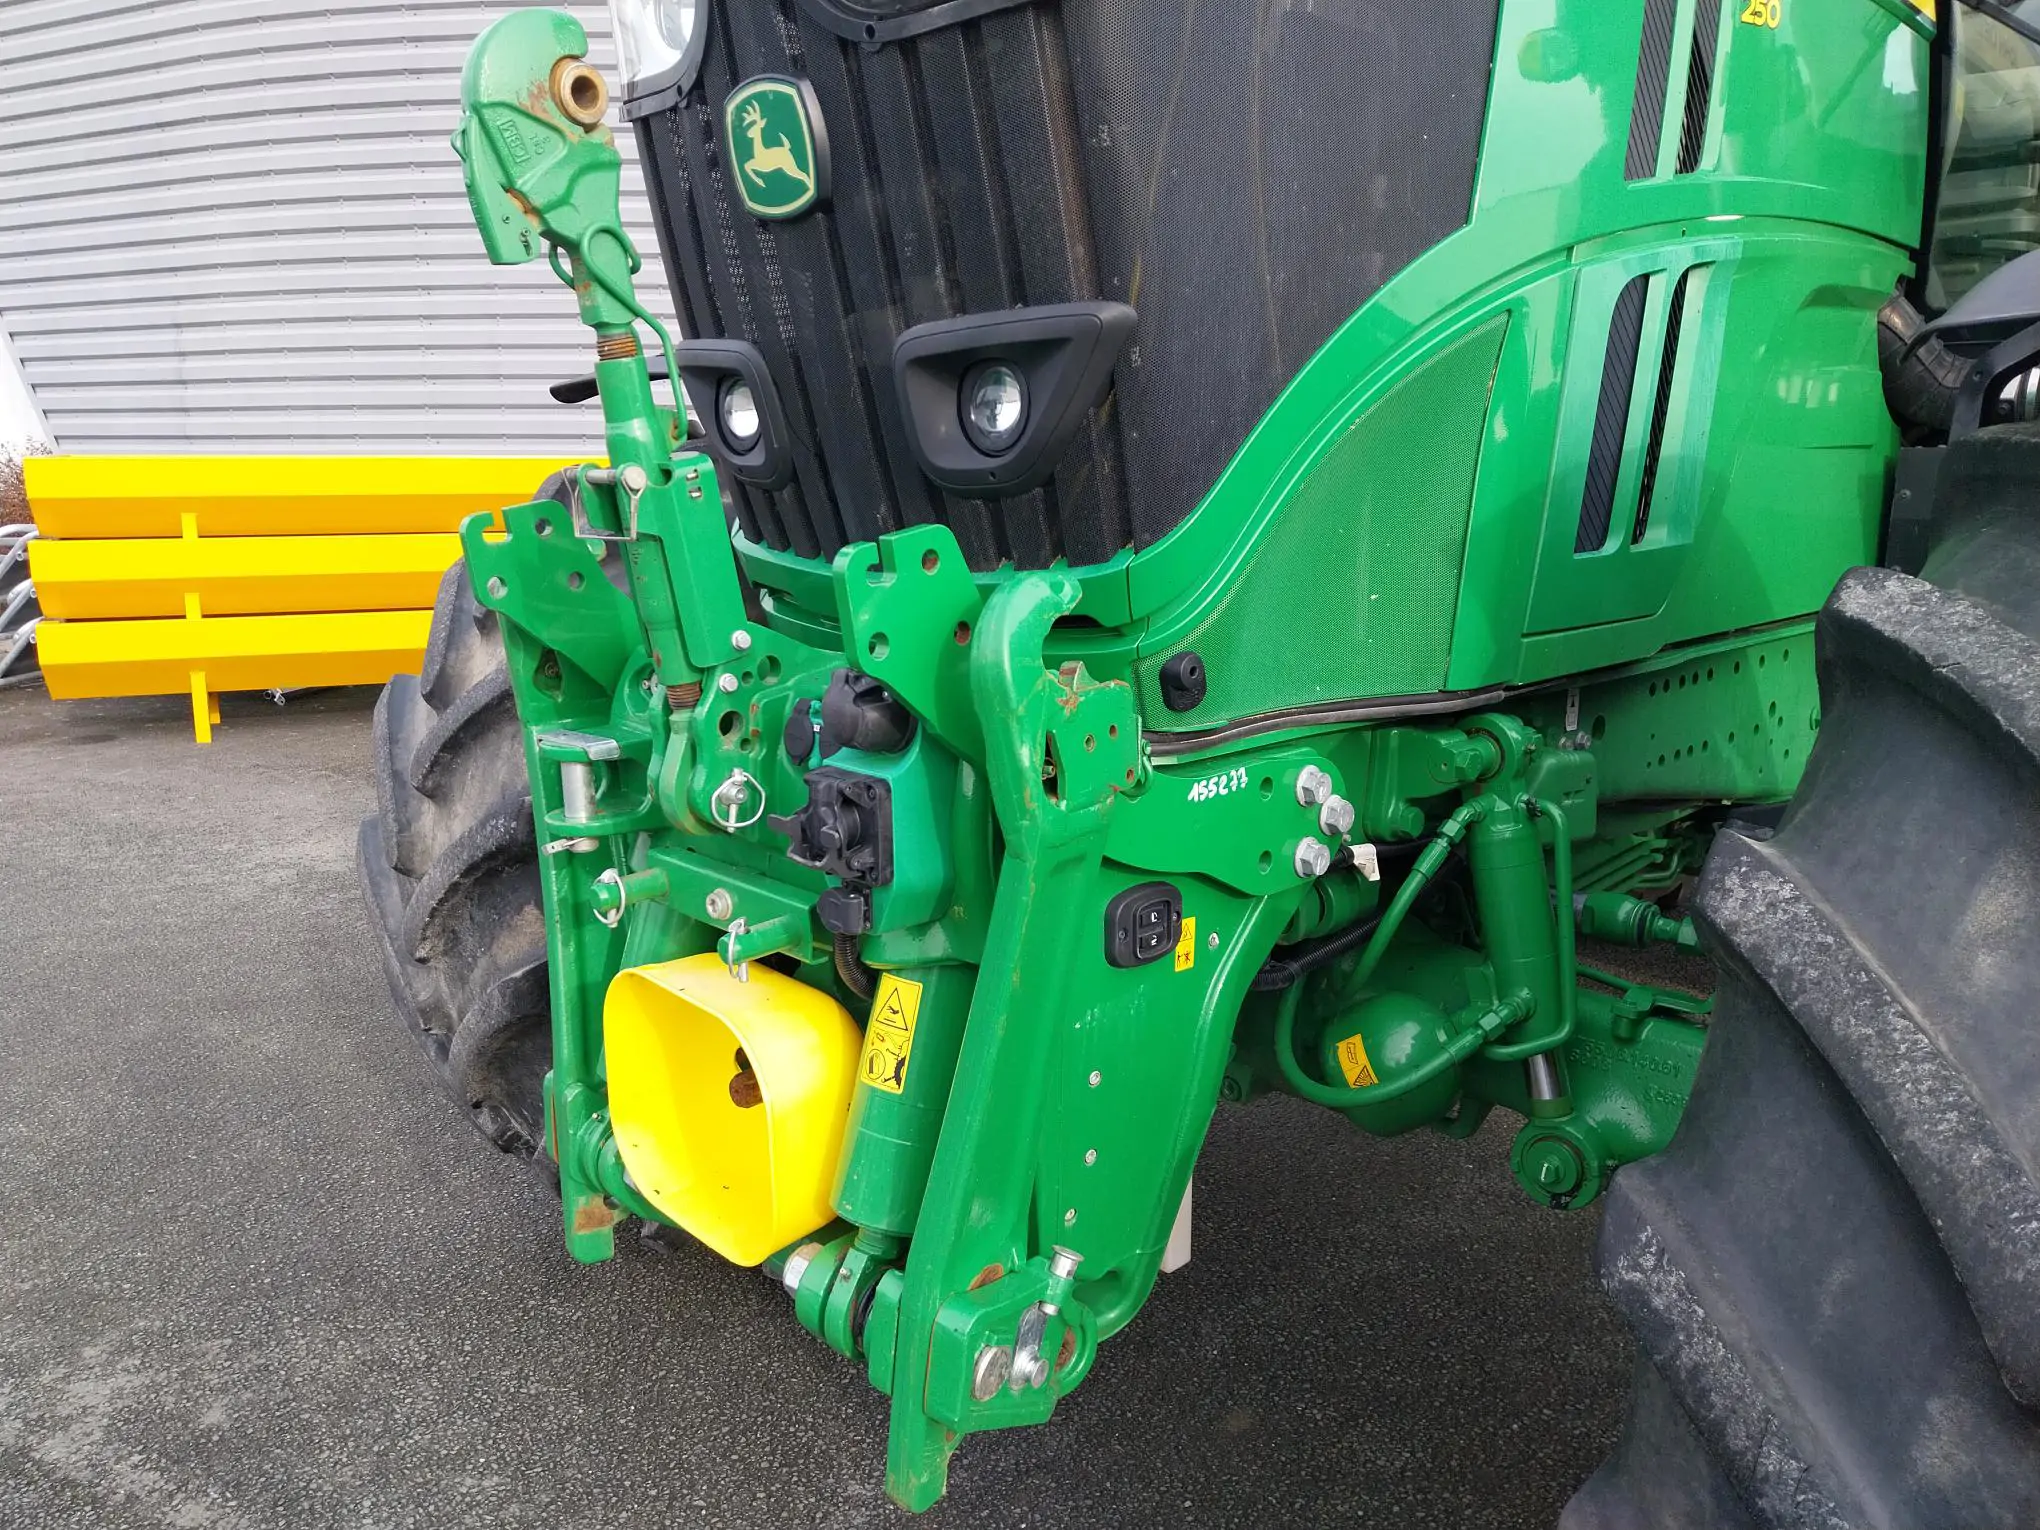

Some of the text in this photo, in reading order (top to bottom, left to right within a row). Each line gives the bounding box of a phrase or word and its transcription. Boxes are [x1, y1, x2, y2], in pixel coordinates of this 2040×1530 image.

[1740, 0, 1781, 30] 250
[500, 122, 528, 159] CBM
[1187, 766, 1248, 803] 155277
